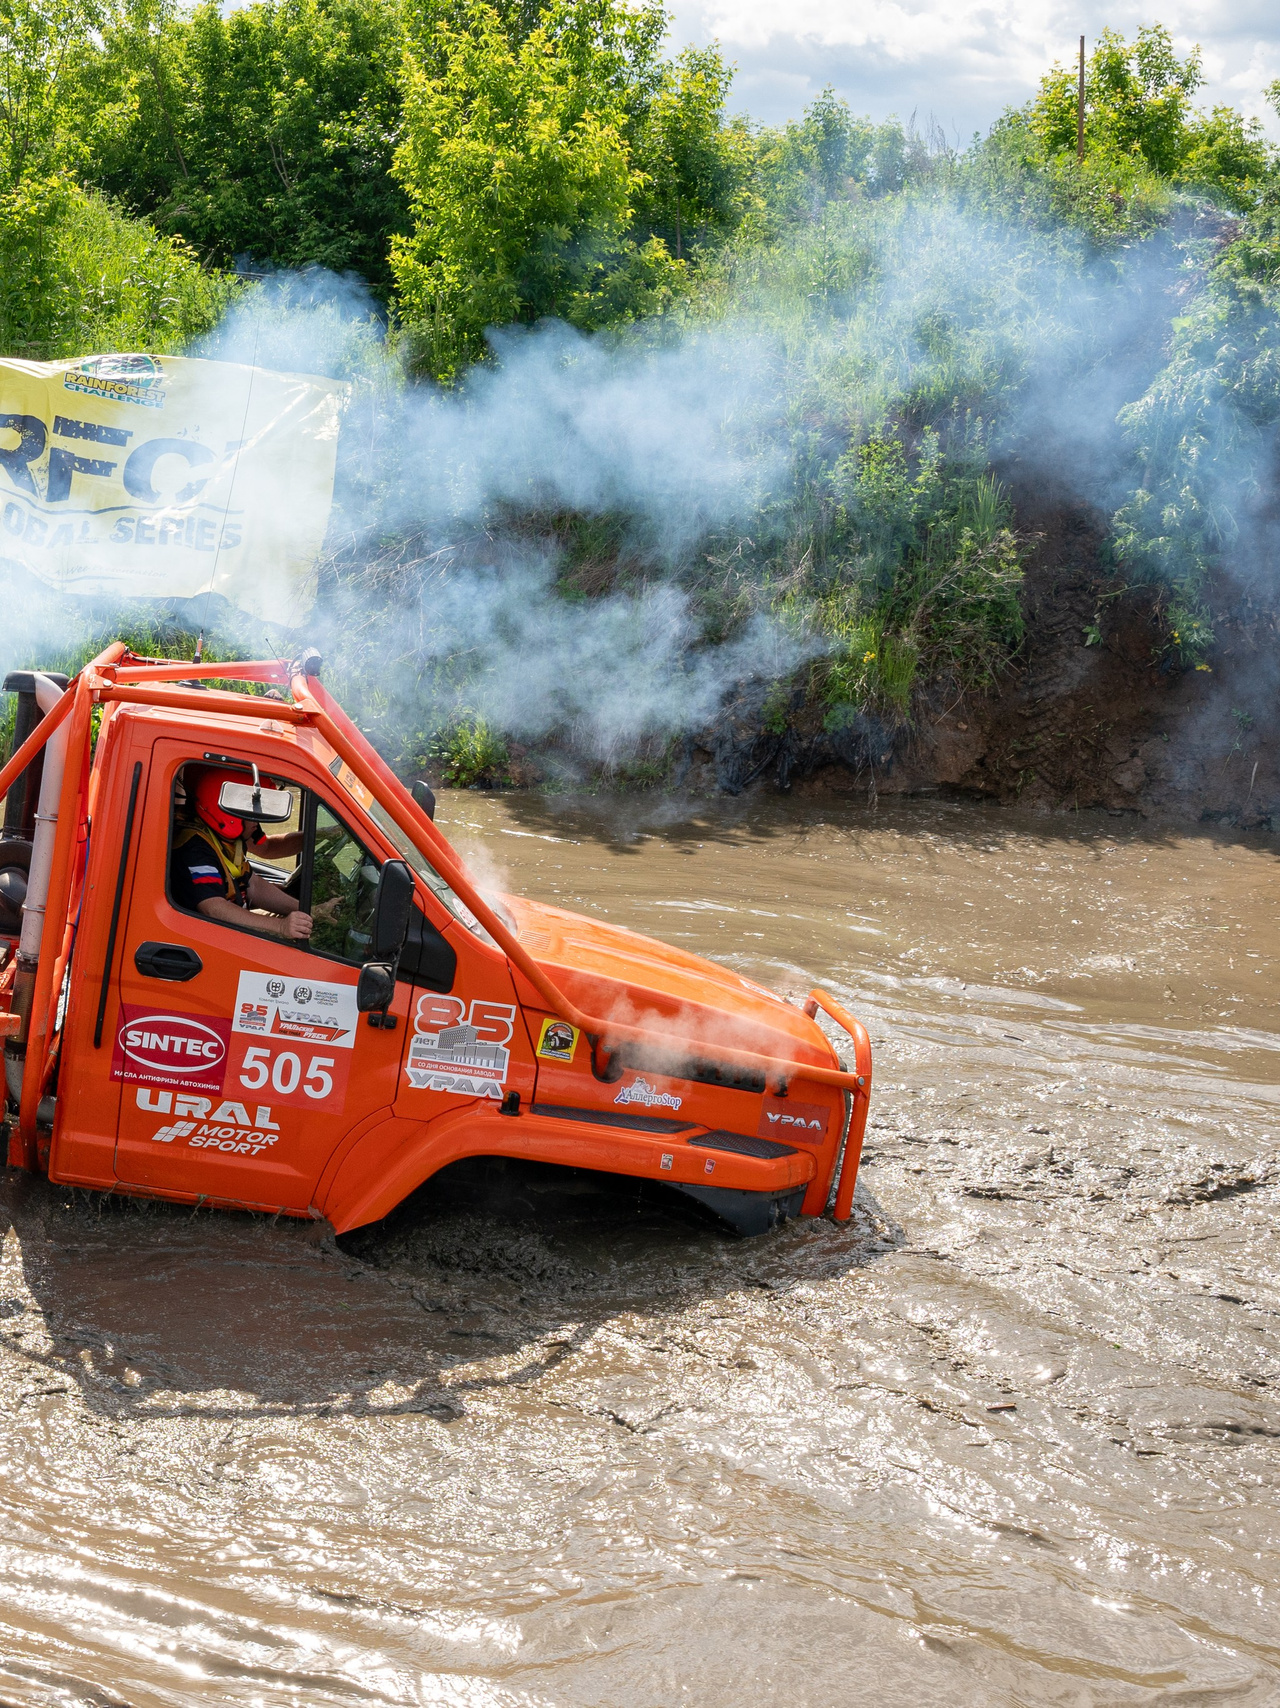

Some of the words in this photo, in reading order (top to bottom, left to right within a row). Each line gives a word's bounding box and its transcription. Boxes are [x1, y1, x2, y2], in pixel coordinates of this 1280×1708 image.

[64, 383, 164, 408] CHALLENGE
[65, 373, 166, 402] RAINFOREST
[109, 514, 243, 552] SERIES
[241, 1002, 268, 1016] 85
[282, 1009, 339, 1026] УРАЛ
[414, 993, 516, 1046] 85
[125, 1030, 218, 1058] SINTEC
[303, 1031, 329, 1041] РУБЕЖ
[414, 1036, 436, 1046] лет
[114, 1070, 138, 1079] МАСЛА
[138, 1073, 179, 1085] АНТИФРИЗЫ
[180, 1079, 220, 1091] АВТОХИМИЯ
[239, 1046, 335, 1099] 505
[426, 1062, 438, 1070] ДНЯ
[439, 1064, 473, 1075] ОСНОВАНИЯ
[473, 1068, 496, 1078] ЗАВОДА
[409, 1071, 501, 1097] УРАЛ
[136, 1087, 281, 1131] URAL
[626, 1090, 681, 1109] АллергоStop
[766, 1112, 822, 1130] УРАЛ
[188, 1135, 267, 1156] SPORT
[197, 1124, 280, 1146] MOTOR
